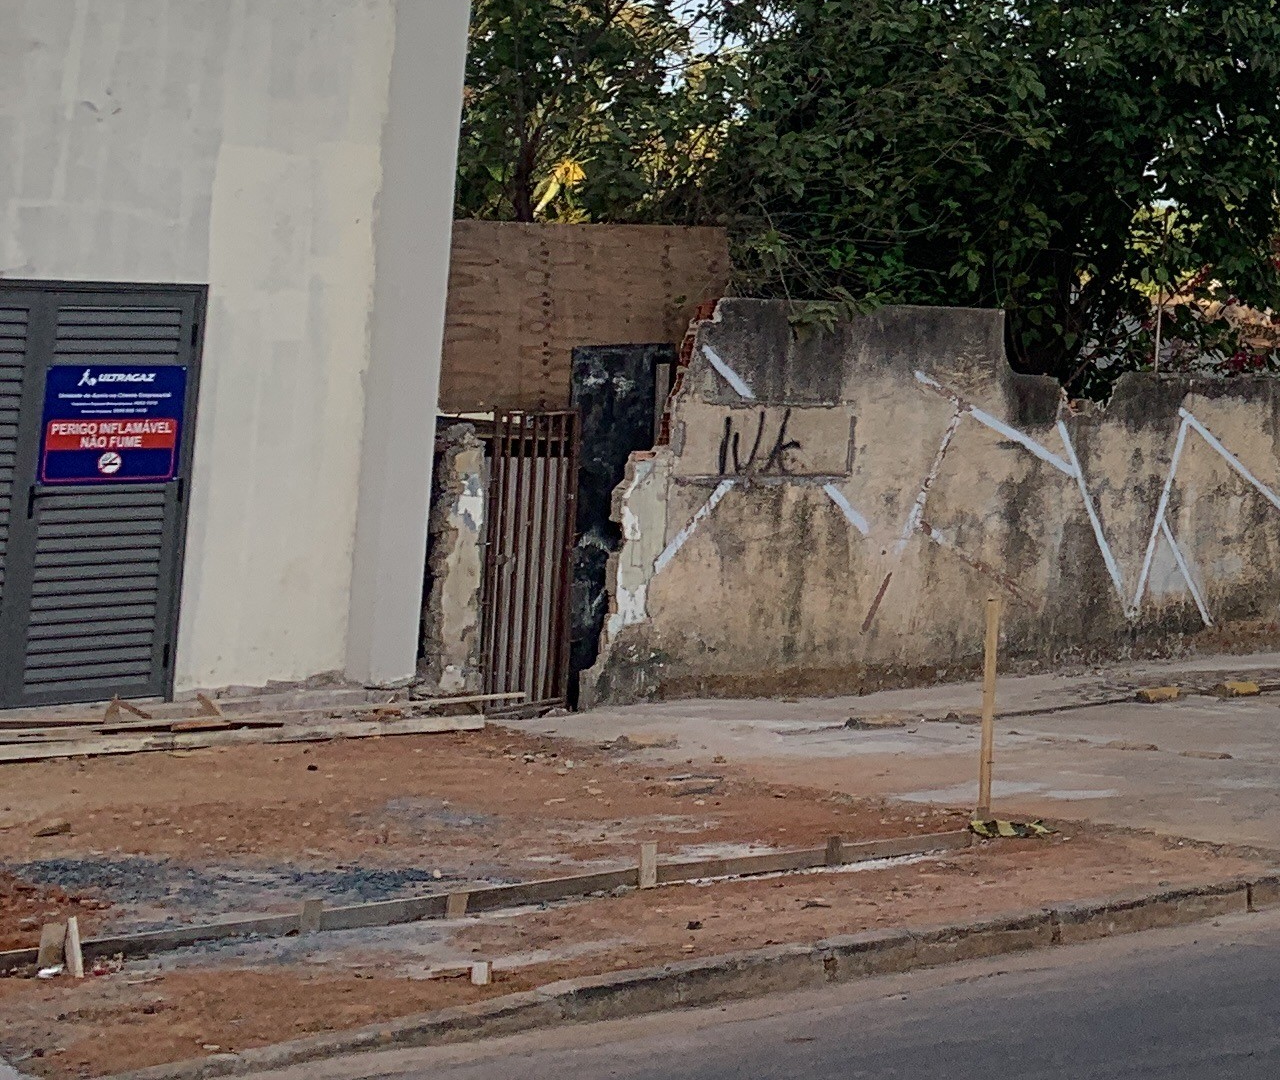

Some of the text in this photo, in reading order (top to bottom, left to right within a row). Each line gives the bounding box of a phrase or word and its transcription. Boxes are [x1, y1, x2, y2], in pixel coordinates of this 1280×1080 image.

[98, 373, 156, 382] ULTRAGAZ
[51, 419, 172, 435] PERIGO INFLAMÁVEL
[80, 431, 143, 448] NÃO FUME
